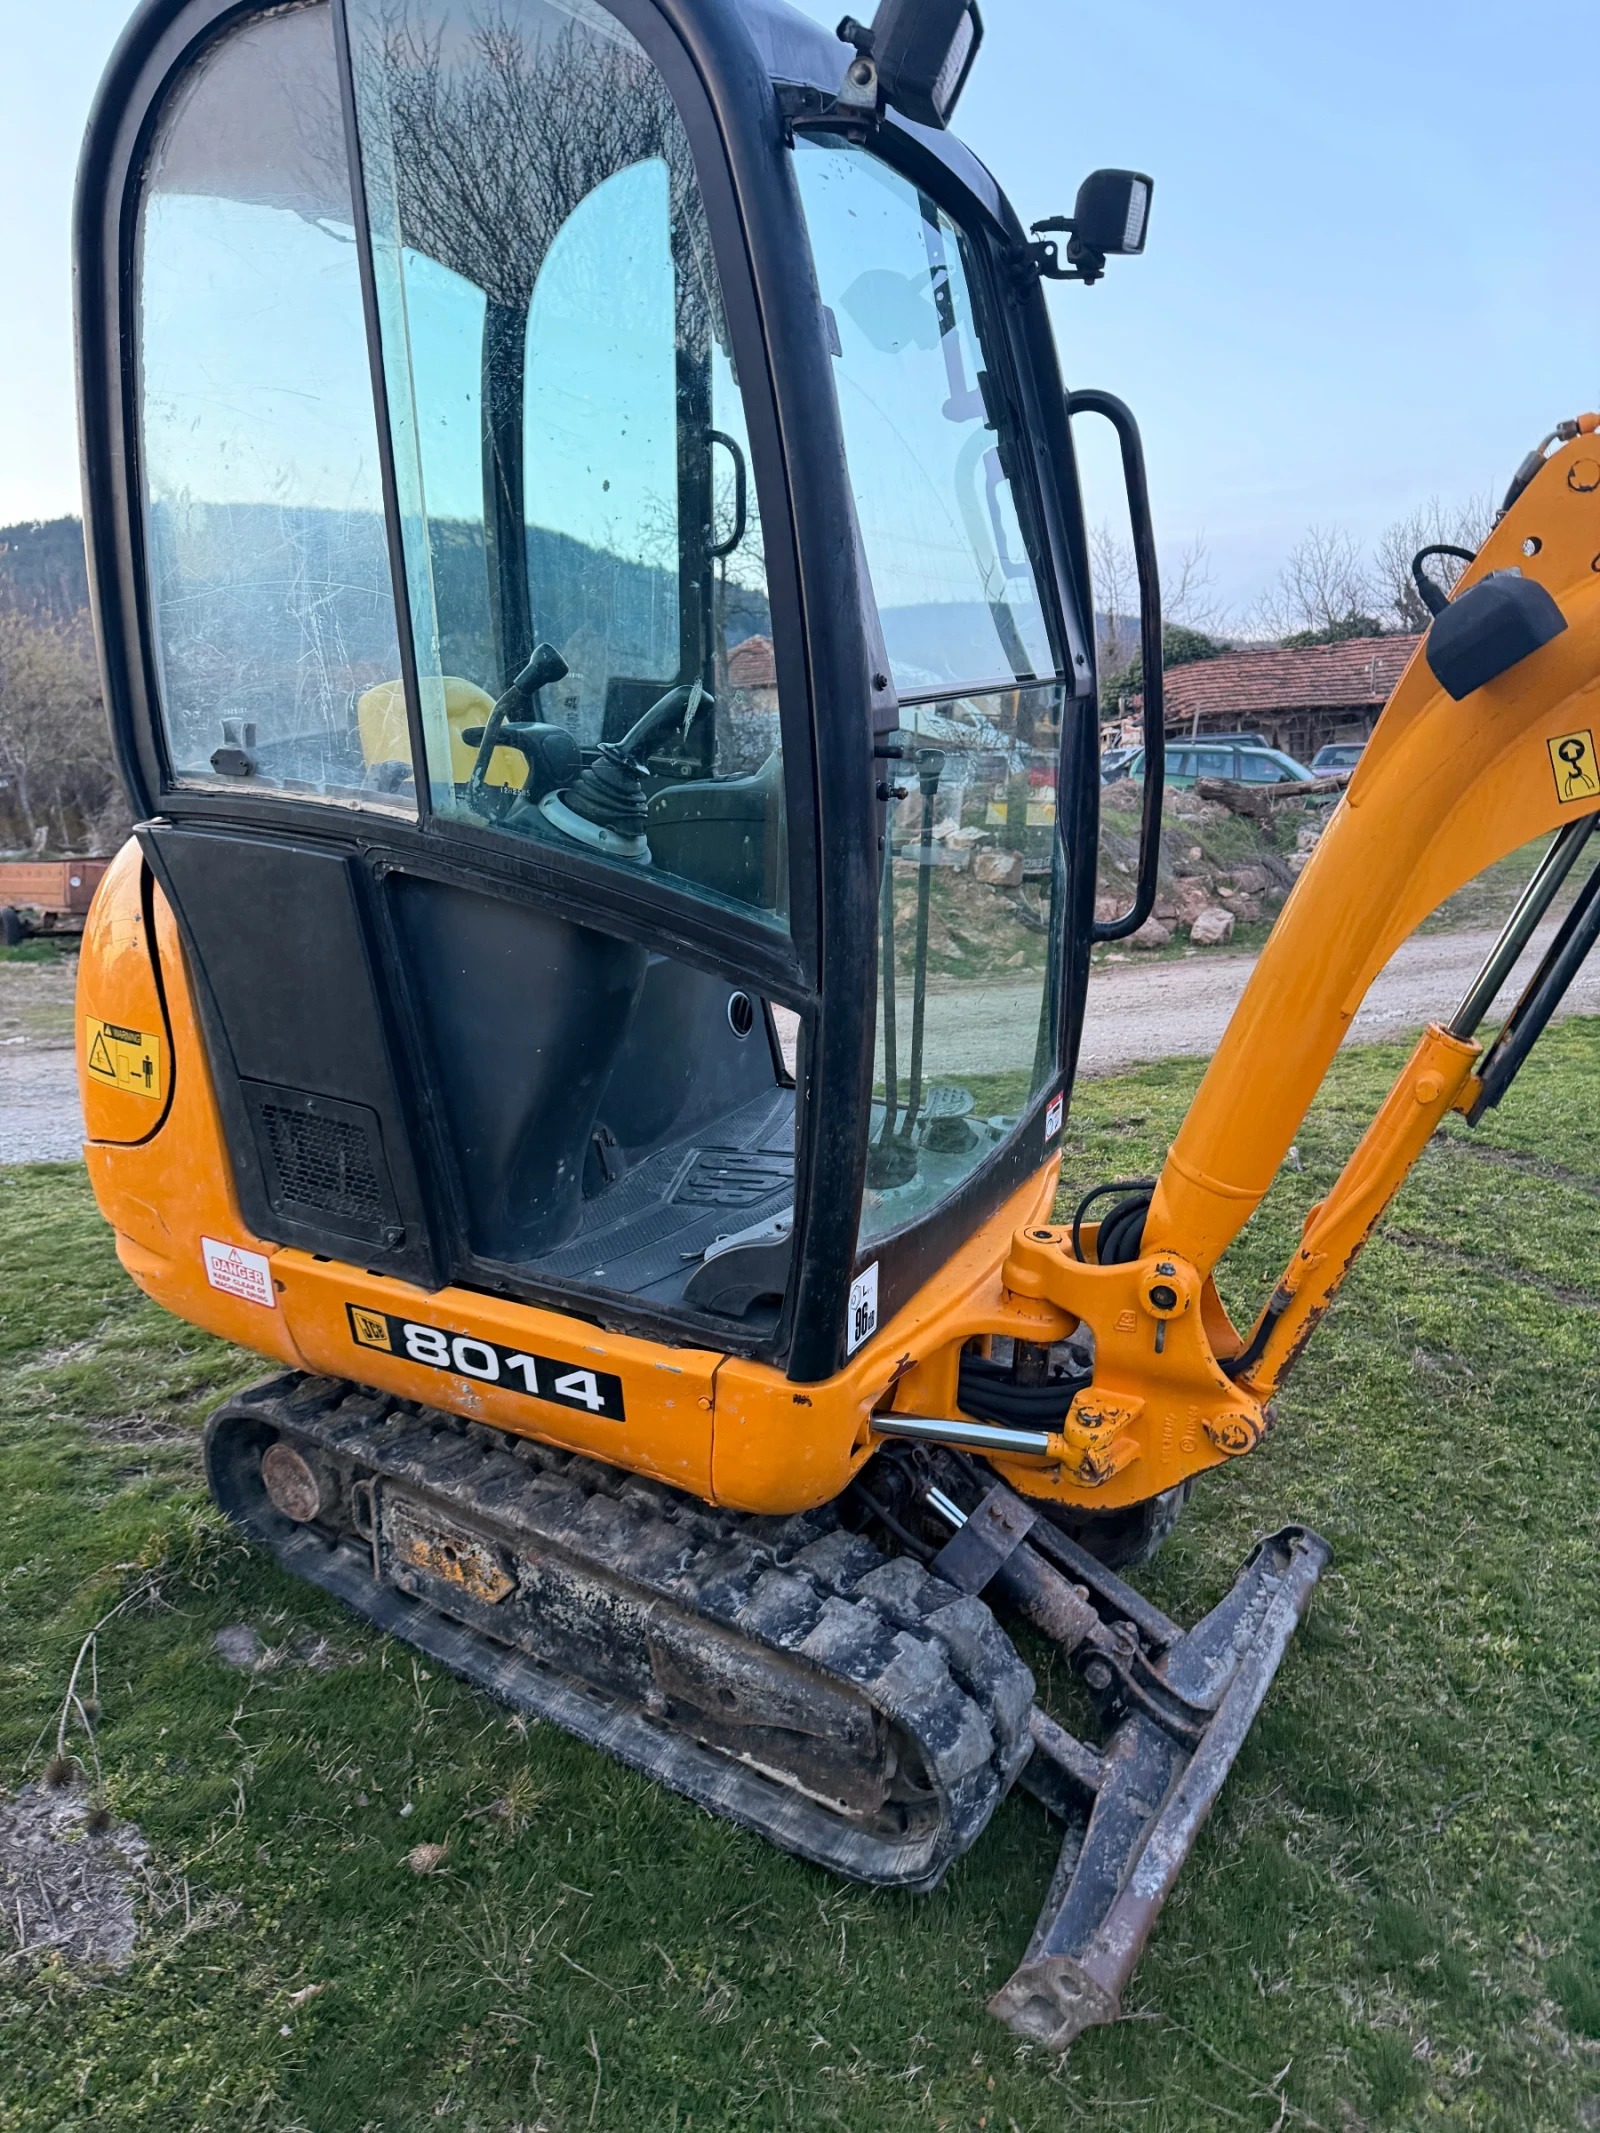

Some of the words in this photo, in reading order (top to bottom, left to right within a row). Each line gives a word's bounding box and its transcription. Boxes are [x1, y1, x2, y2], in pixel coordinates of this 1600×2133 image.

[113, 1028, 140, 1043] WARNING
[212, 1257, 264, 1285] DANGER
[213, 1272, 231, 1281] KEEP
[233, 1279, 255, 1290] CLEAR
[215, 1280, 244, 1294] MACHINE
[360, 1316, 386, 1339] JCB
[402, 1323, 606, 1411] 8014
